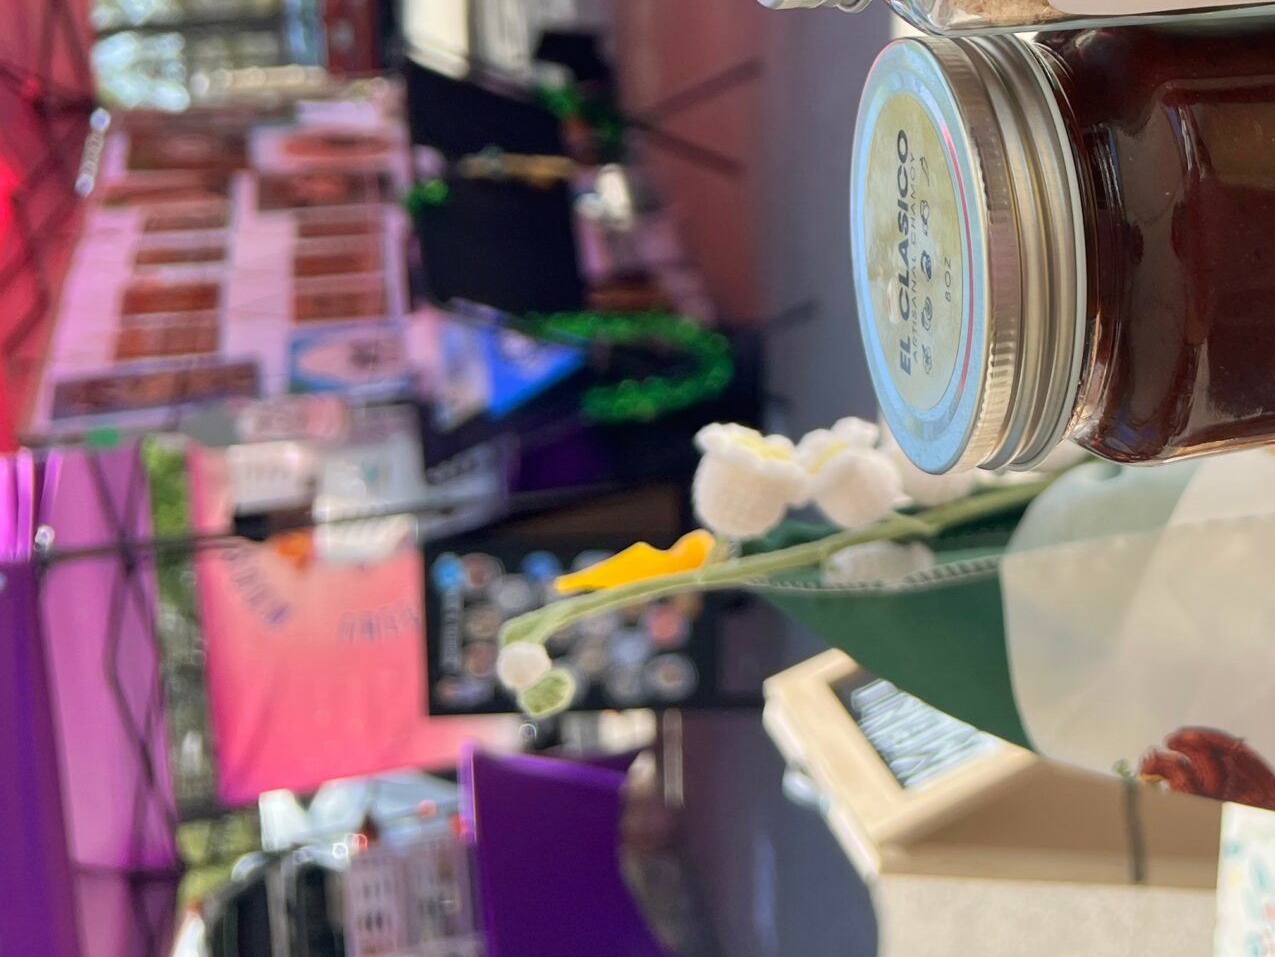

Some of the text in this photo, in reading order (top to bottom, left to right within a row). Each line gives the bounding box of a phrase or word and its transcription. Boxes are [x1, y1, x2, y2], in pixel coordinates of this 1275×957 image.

[897, 128, 912, 375] EL CLASICO
[909, 151, 918, 363] ARTISANAL CHAMOY
